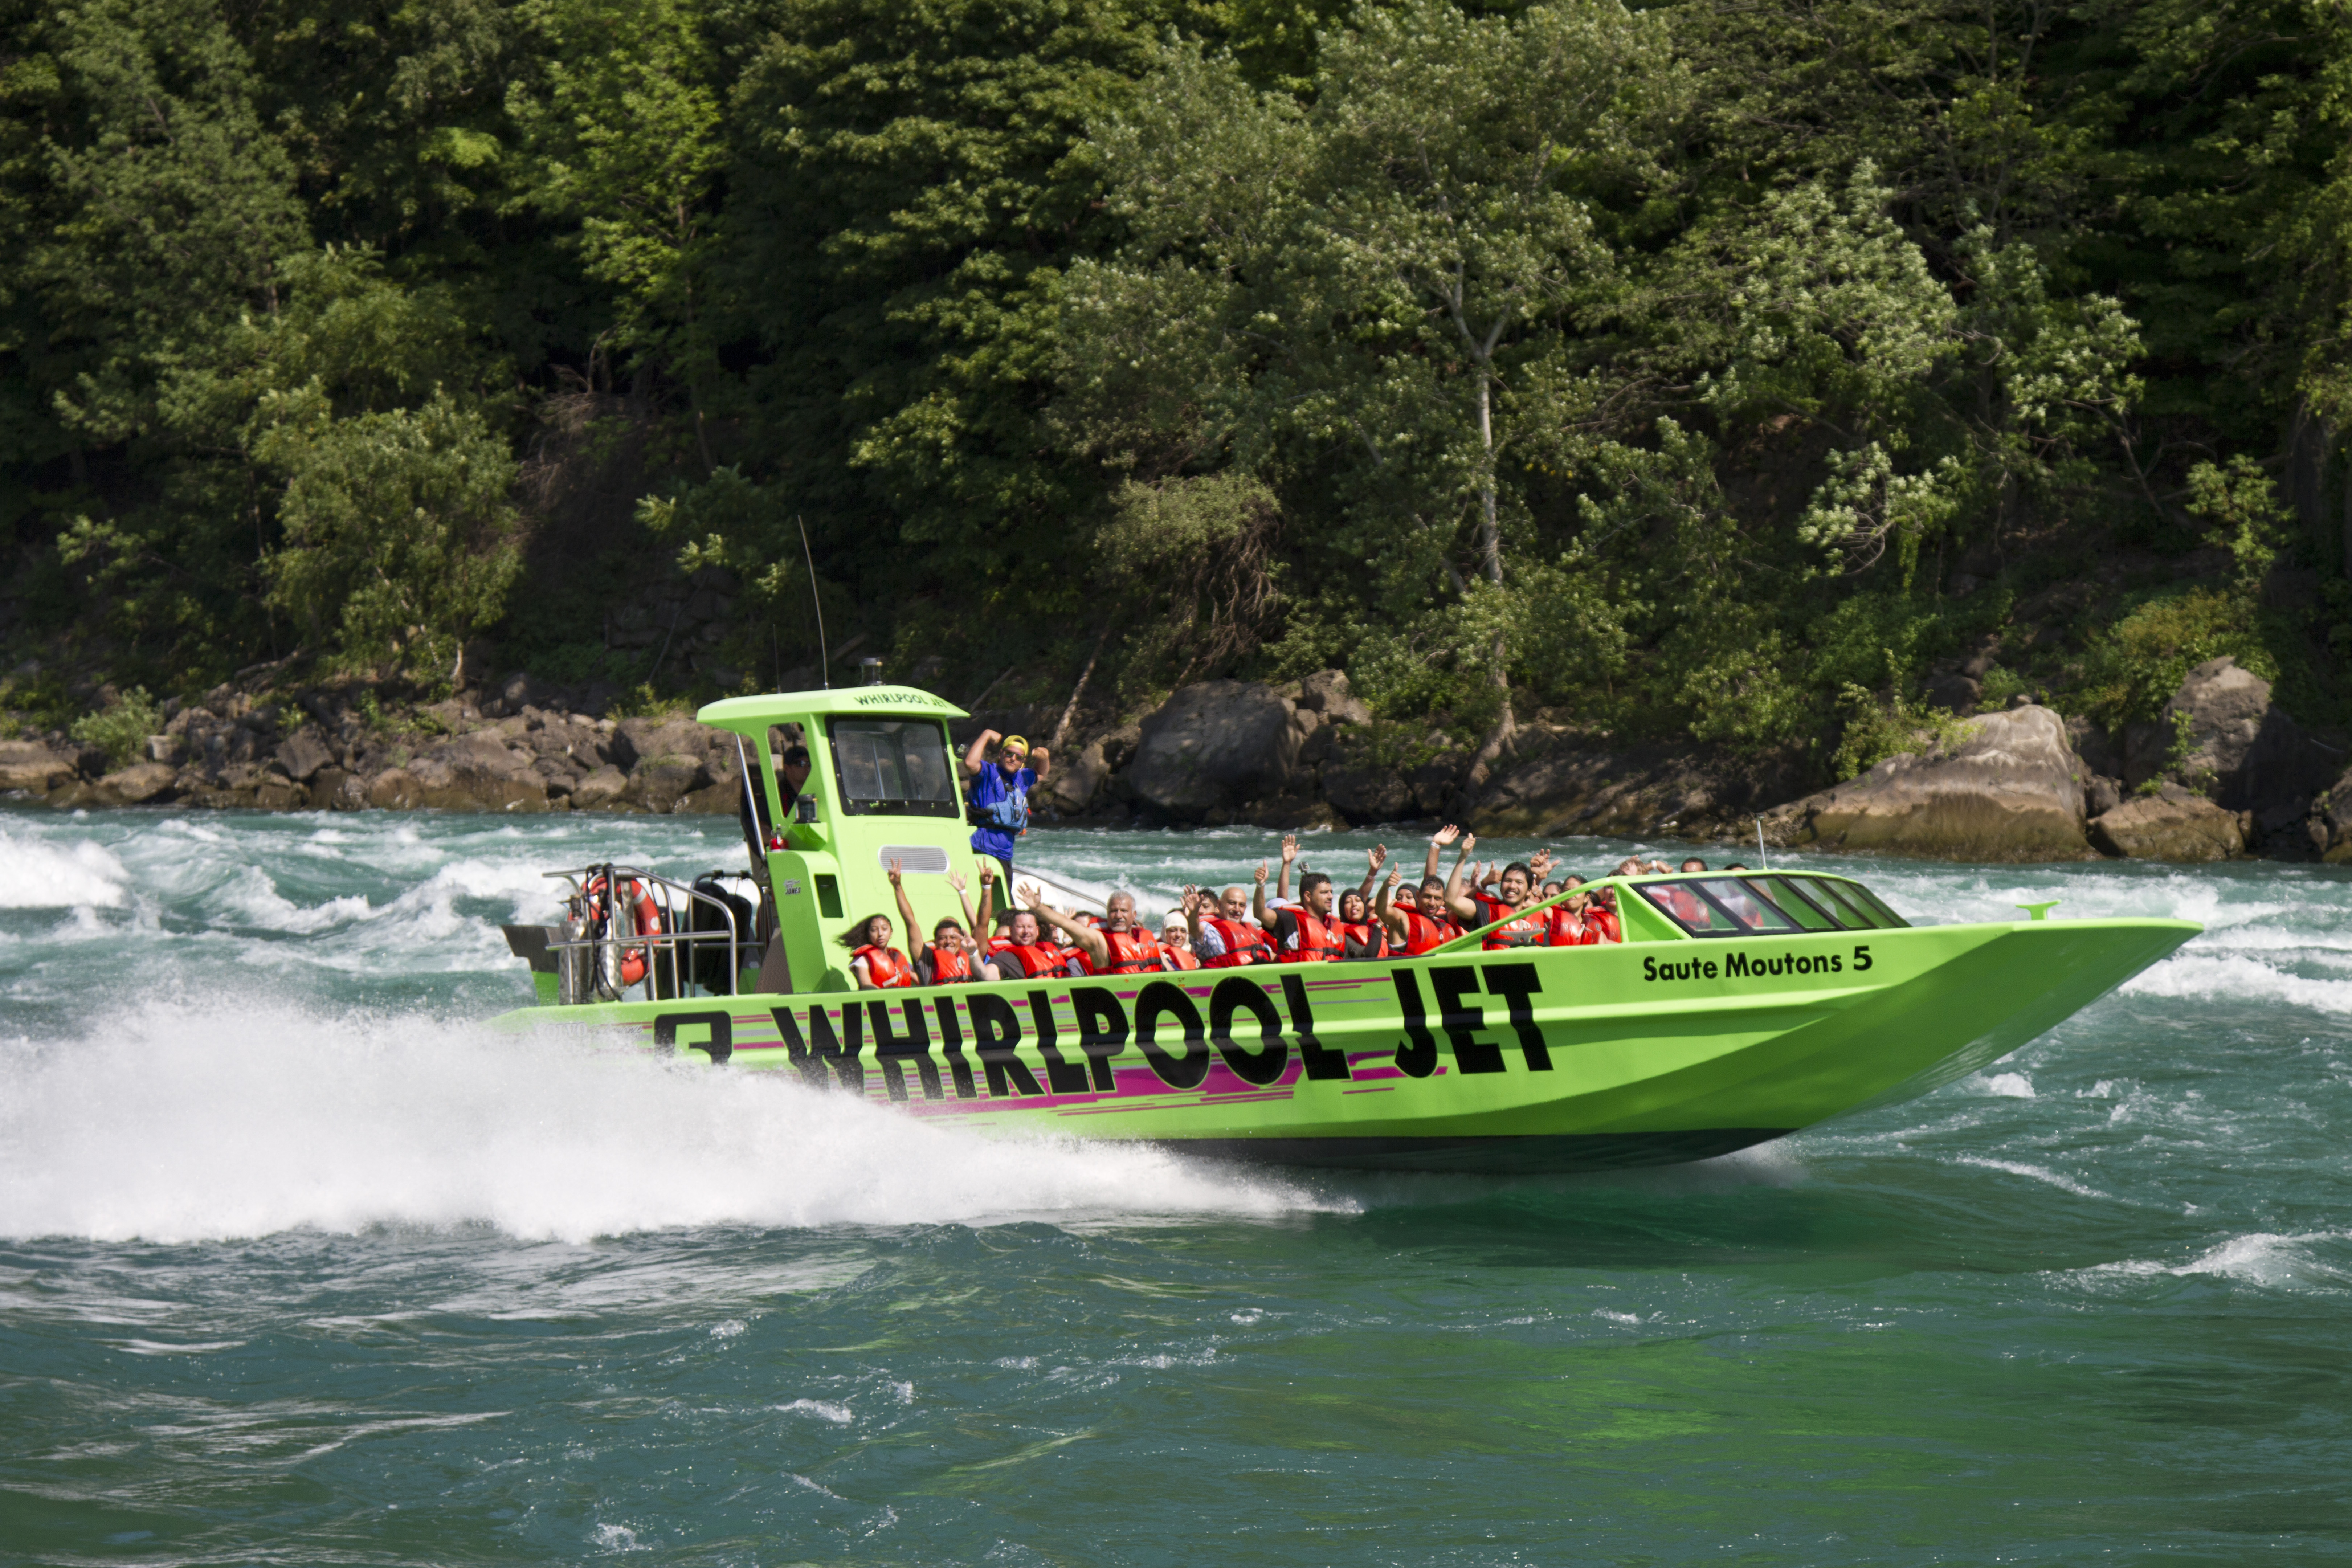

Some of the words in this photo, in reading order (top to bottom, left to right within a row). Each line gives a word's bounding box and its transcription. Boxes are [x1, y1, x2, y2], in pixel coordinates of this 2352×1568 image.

[853, 693, 928, 705] WHIRLPOOL
[930, 697, 947, 708] JET
[1643, 956, 1718, 982] Saute
[1726, 952, 1843, 977] Moutons
[1853, 945, 1873, 971] 5
[769, 974, 1352, 1102] WHIRLPOOL
[1391, 963, 1554, 1078] JET
